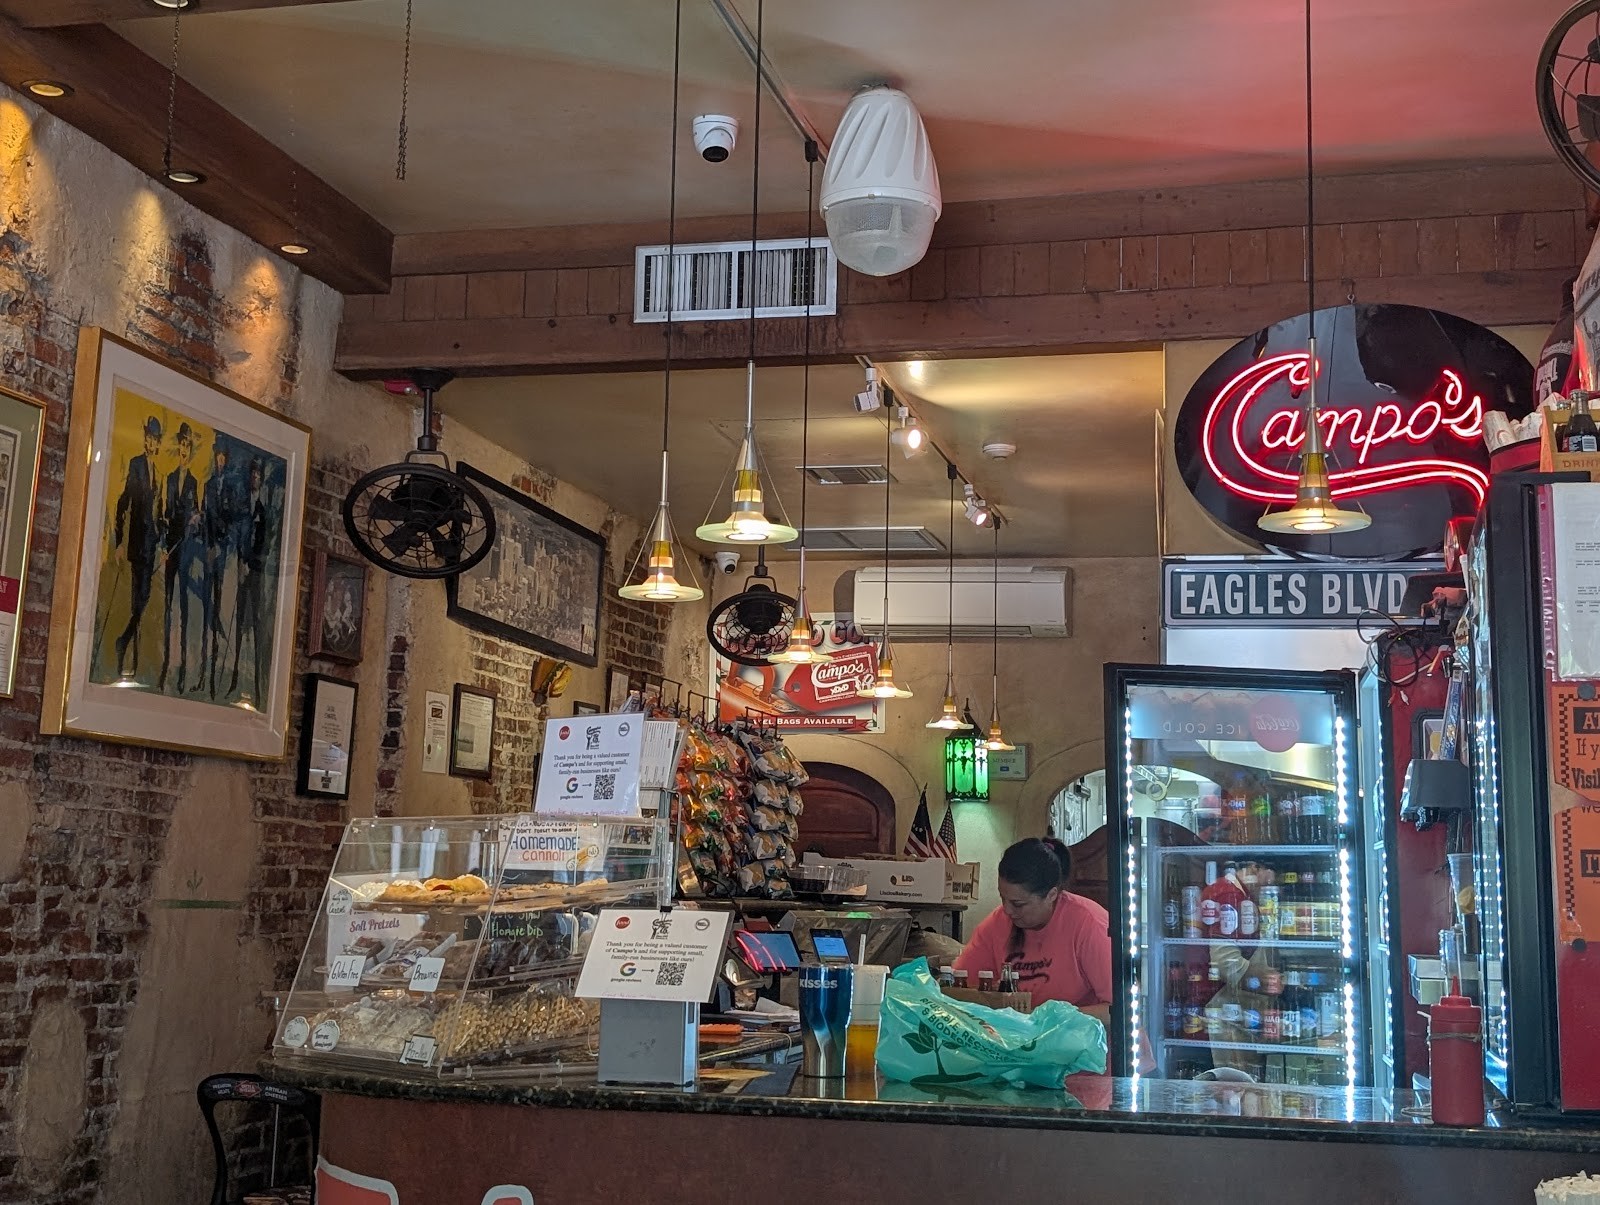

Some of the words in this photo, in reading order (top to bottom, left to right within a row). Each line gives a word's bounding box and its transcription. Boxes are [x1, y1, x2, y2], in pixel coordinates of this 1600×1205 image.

[1203, 352, 1488, 503] Campo's
[1180, 573, 1307, 615] EAGLES
[1322, 573, 1406, 615] BLVD
[811, 659, 865, 688] Campo's
[777, 717, 800, 725] BAGS
[803, 717, 854, 725] AVAILABLE
[1576, 738, 1586, 756] If
[349, 919, 367, 933] Soft
[367, 917, 400, 931] Pretzels
[526, 923, 544, 939] Dip
[643, 941, 658, 949] being
[413, 964, 439, 981] Brownies
